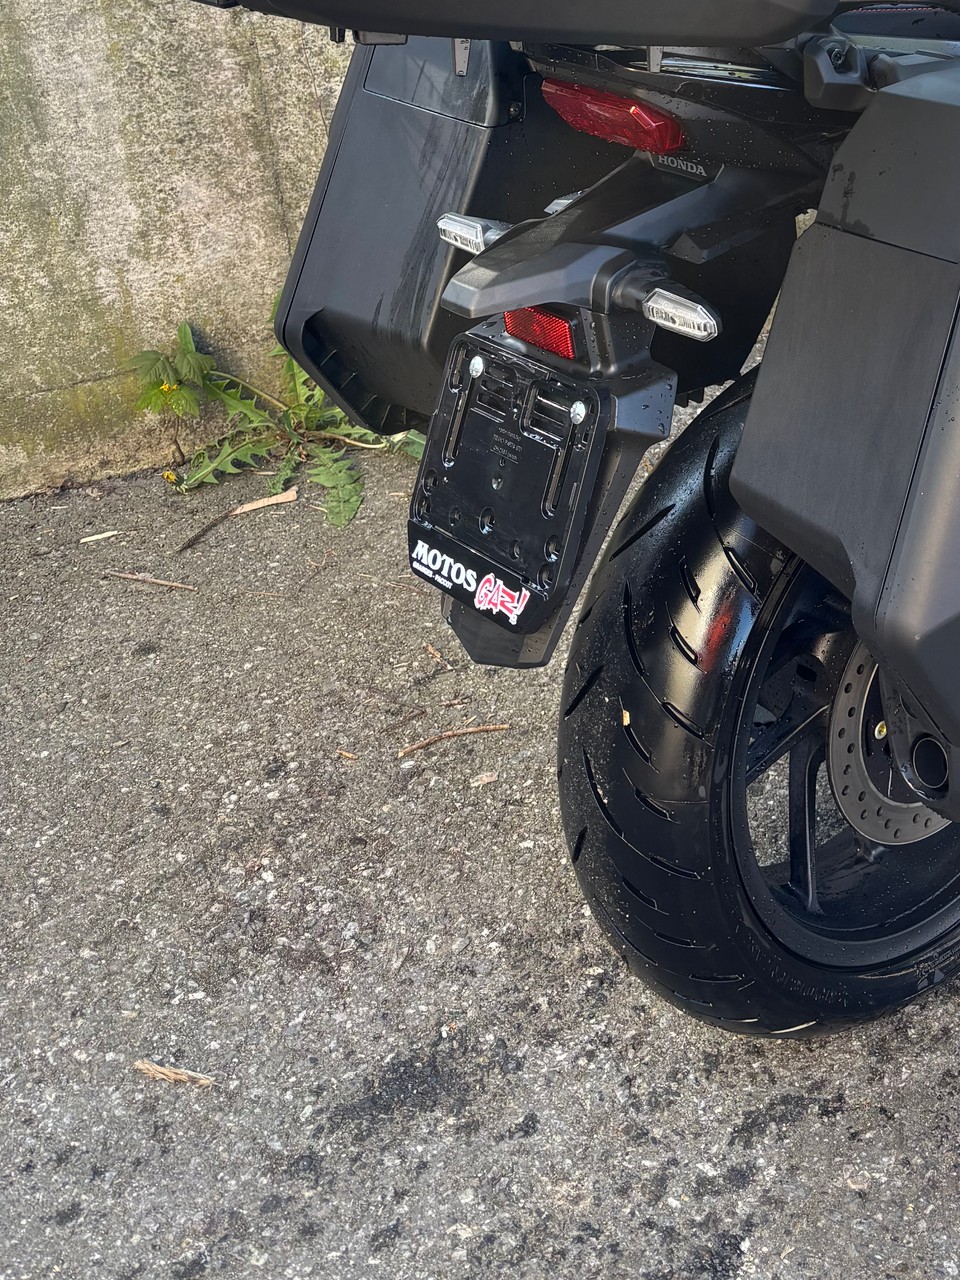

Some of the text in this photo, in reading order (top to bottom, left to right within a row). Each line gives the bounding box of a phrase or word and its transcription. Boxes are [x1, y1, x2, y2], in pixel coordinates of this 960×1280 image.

[657, 154, 708, 177] HONDA
[411, 540, 531, 625] MOTOS GAZ!
